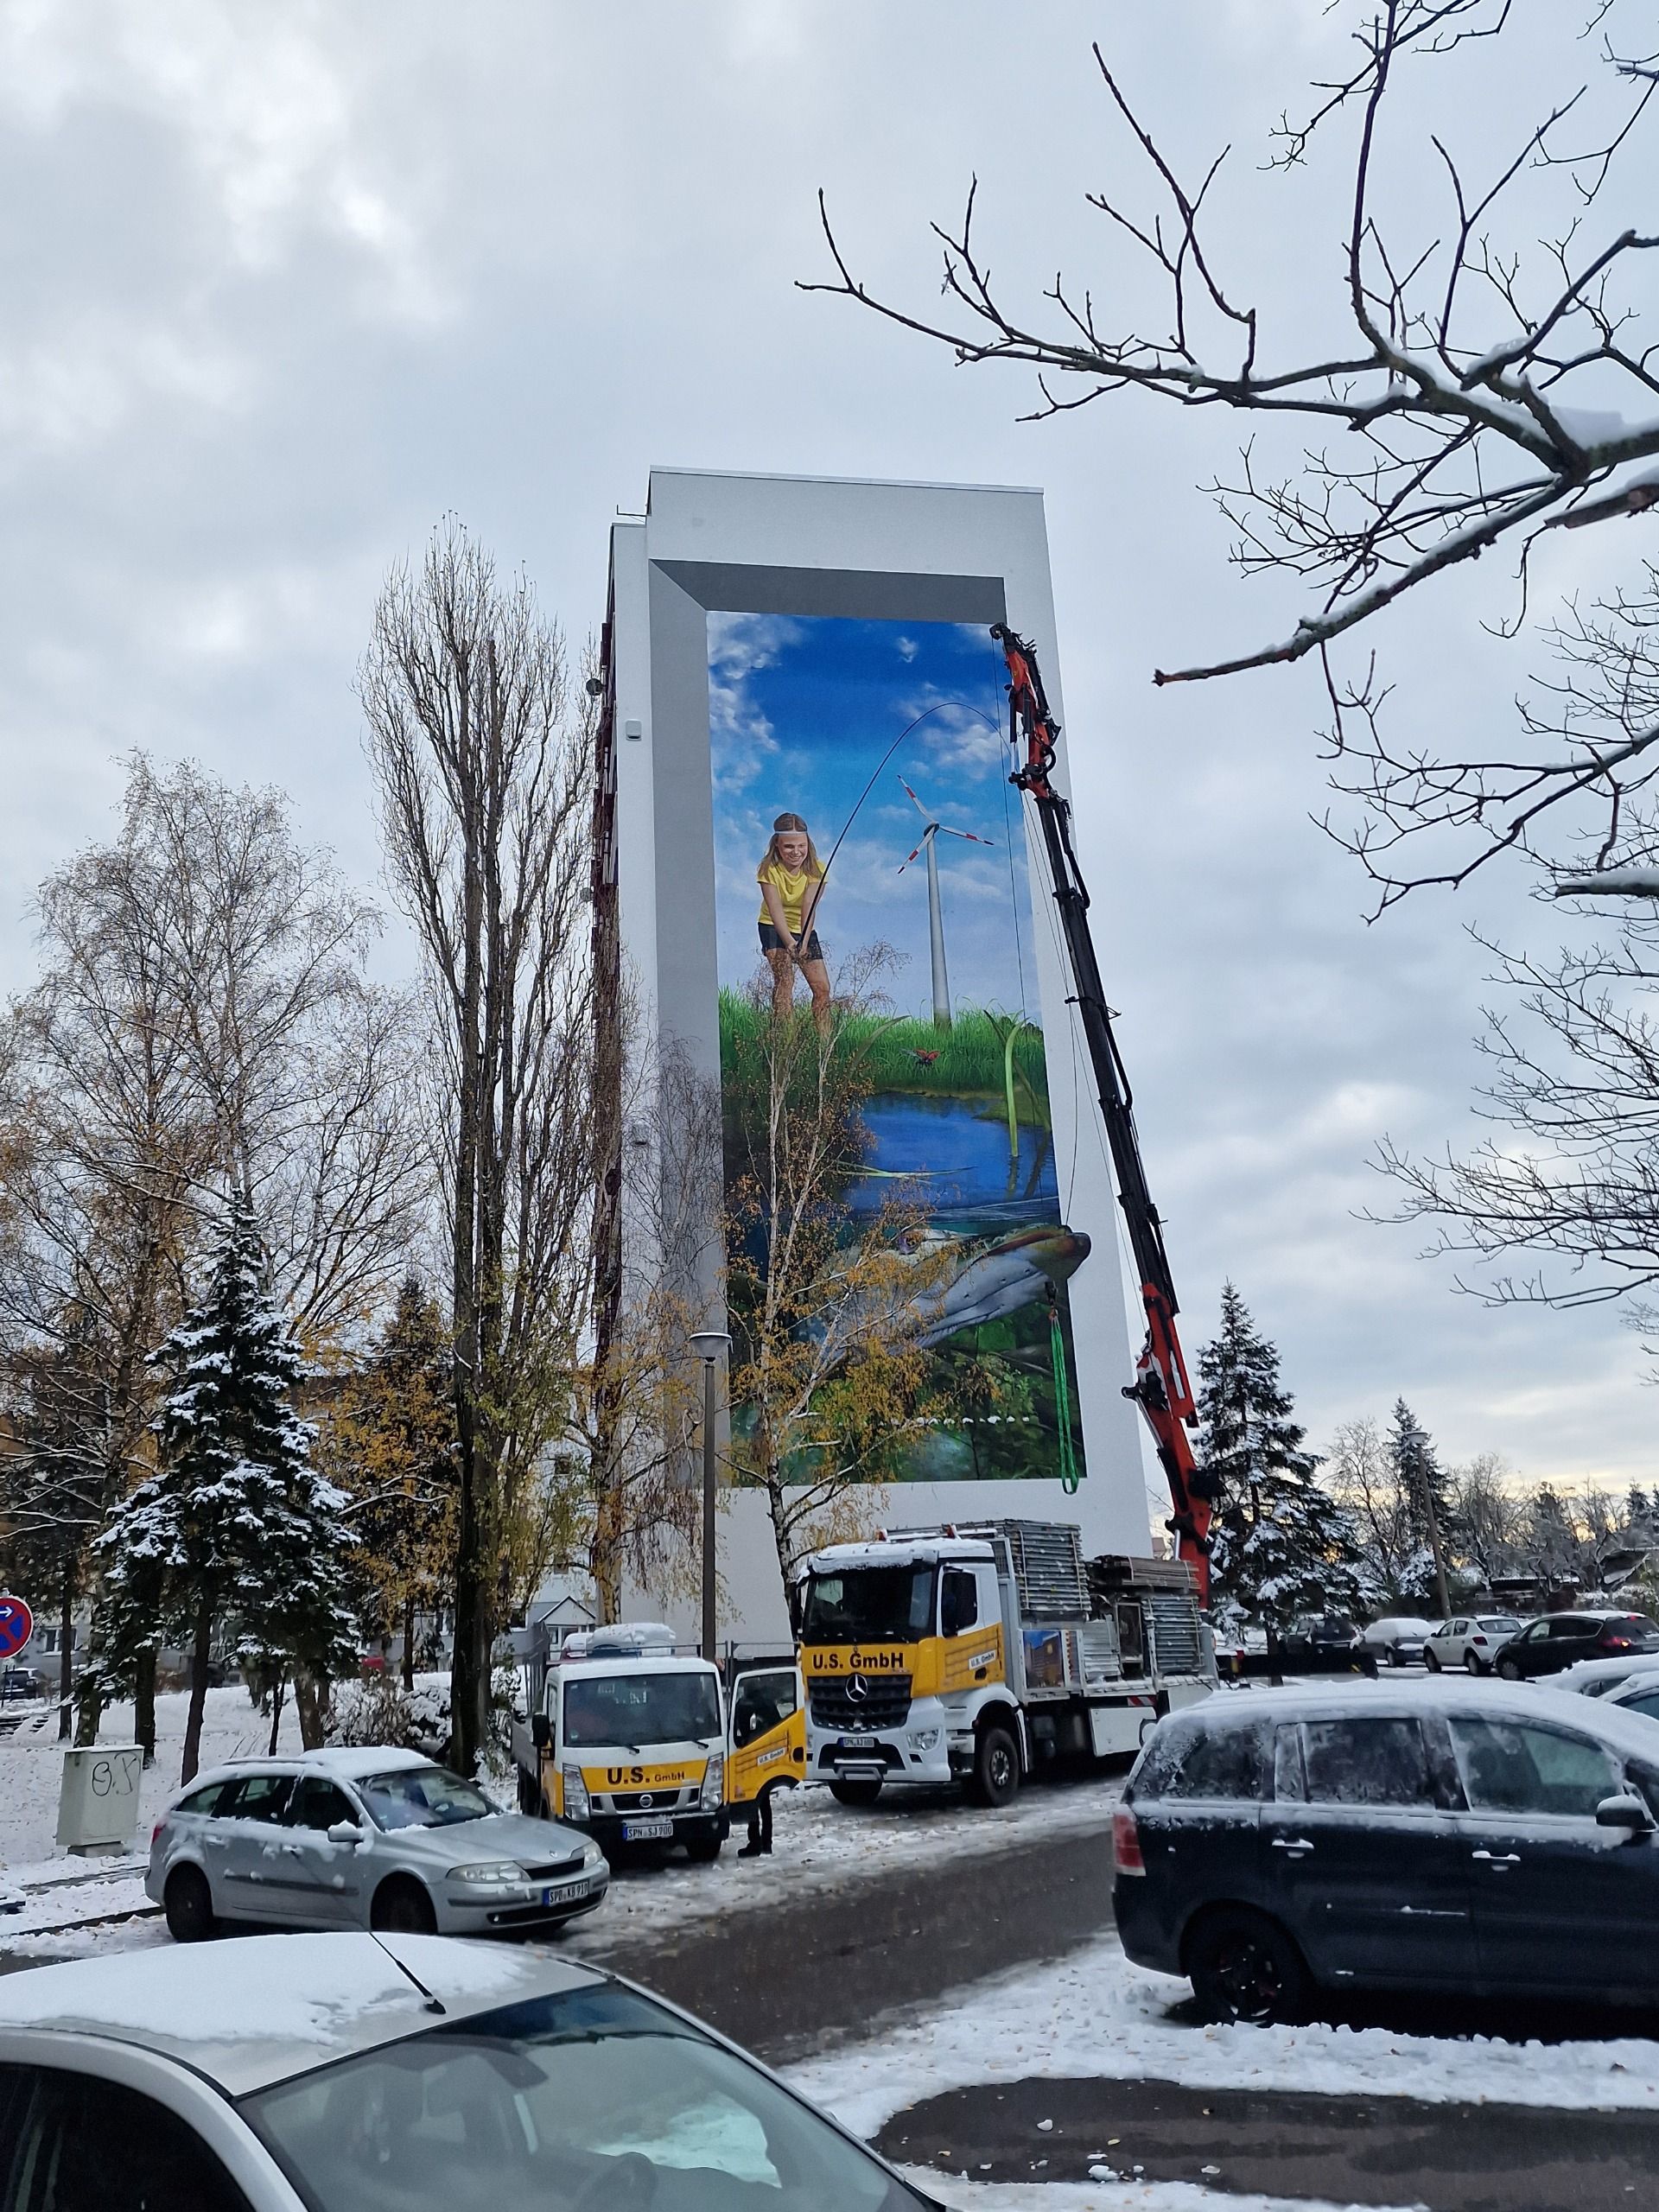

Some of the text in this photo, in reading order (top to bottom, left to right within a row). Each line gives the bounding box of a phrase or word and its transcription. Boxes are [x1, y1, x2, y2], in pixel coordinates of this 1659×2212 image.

[812, 1651, 904, 1669] U.S. GmbH
[607, 1766, 685, 1785] U.S. GmbH
[628, 1827, 643, 1839] SPN
